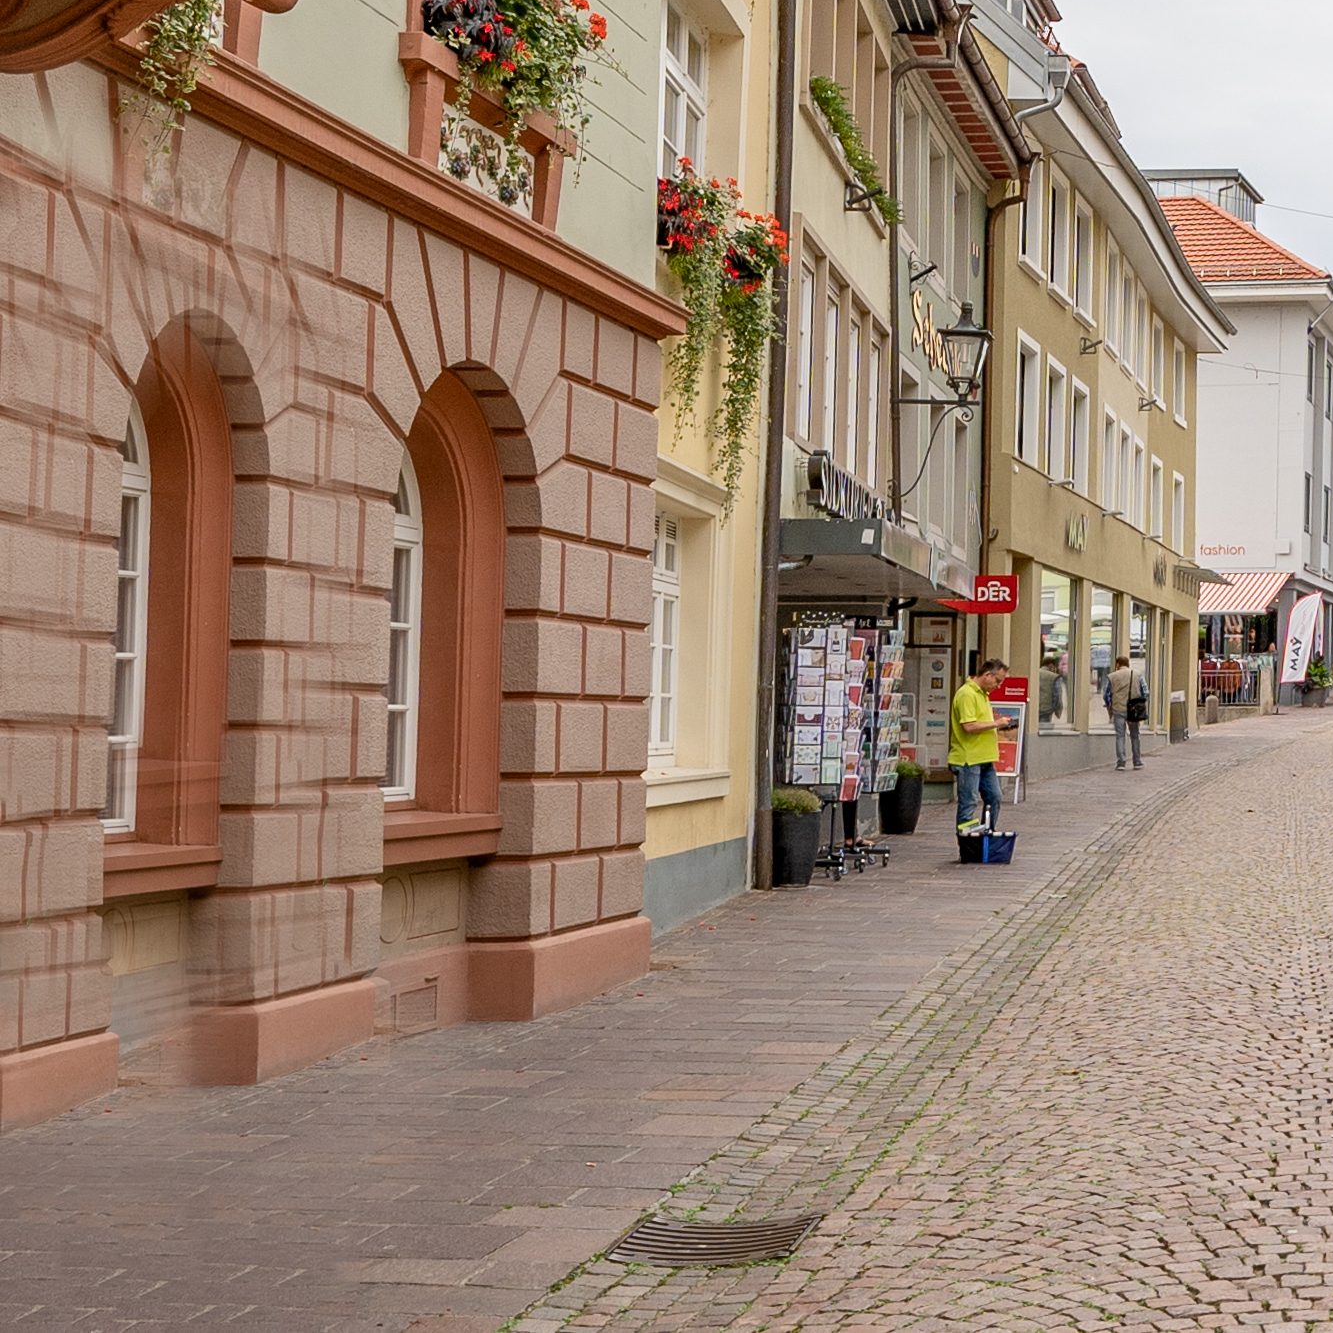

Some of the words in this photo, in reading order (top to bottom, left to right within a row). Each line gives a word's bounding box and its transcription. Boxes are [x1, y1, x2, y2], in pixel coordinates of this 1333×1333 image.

[1200, 543, 1246, 556] fashion
[976, 586, 1012, 602] DER
[1290, 636, 1303, 671] MAY
